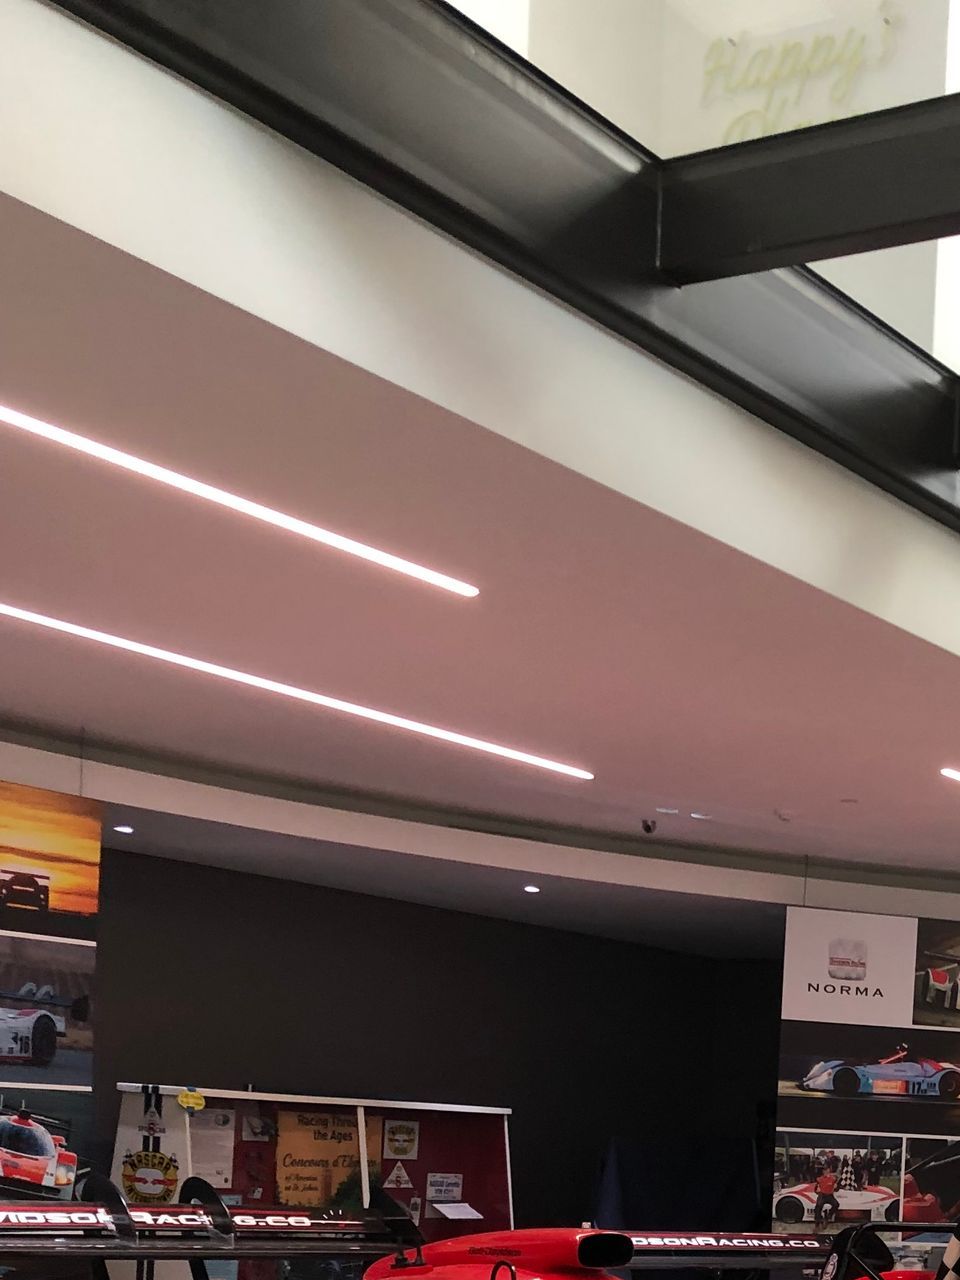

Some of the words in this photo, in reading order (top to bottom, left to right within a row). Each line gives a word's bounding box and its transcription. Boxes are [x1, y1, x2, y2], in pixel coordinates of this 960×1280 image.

[807, 983, 884, 997] NORMA
[297, 1114, 329, 1128] Racing
[313, 1129, 329, 1141] the
[330, 1130, 353, 1143] Ages
